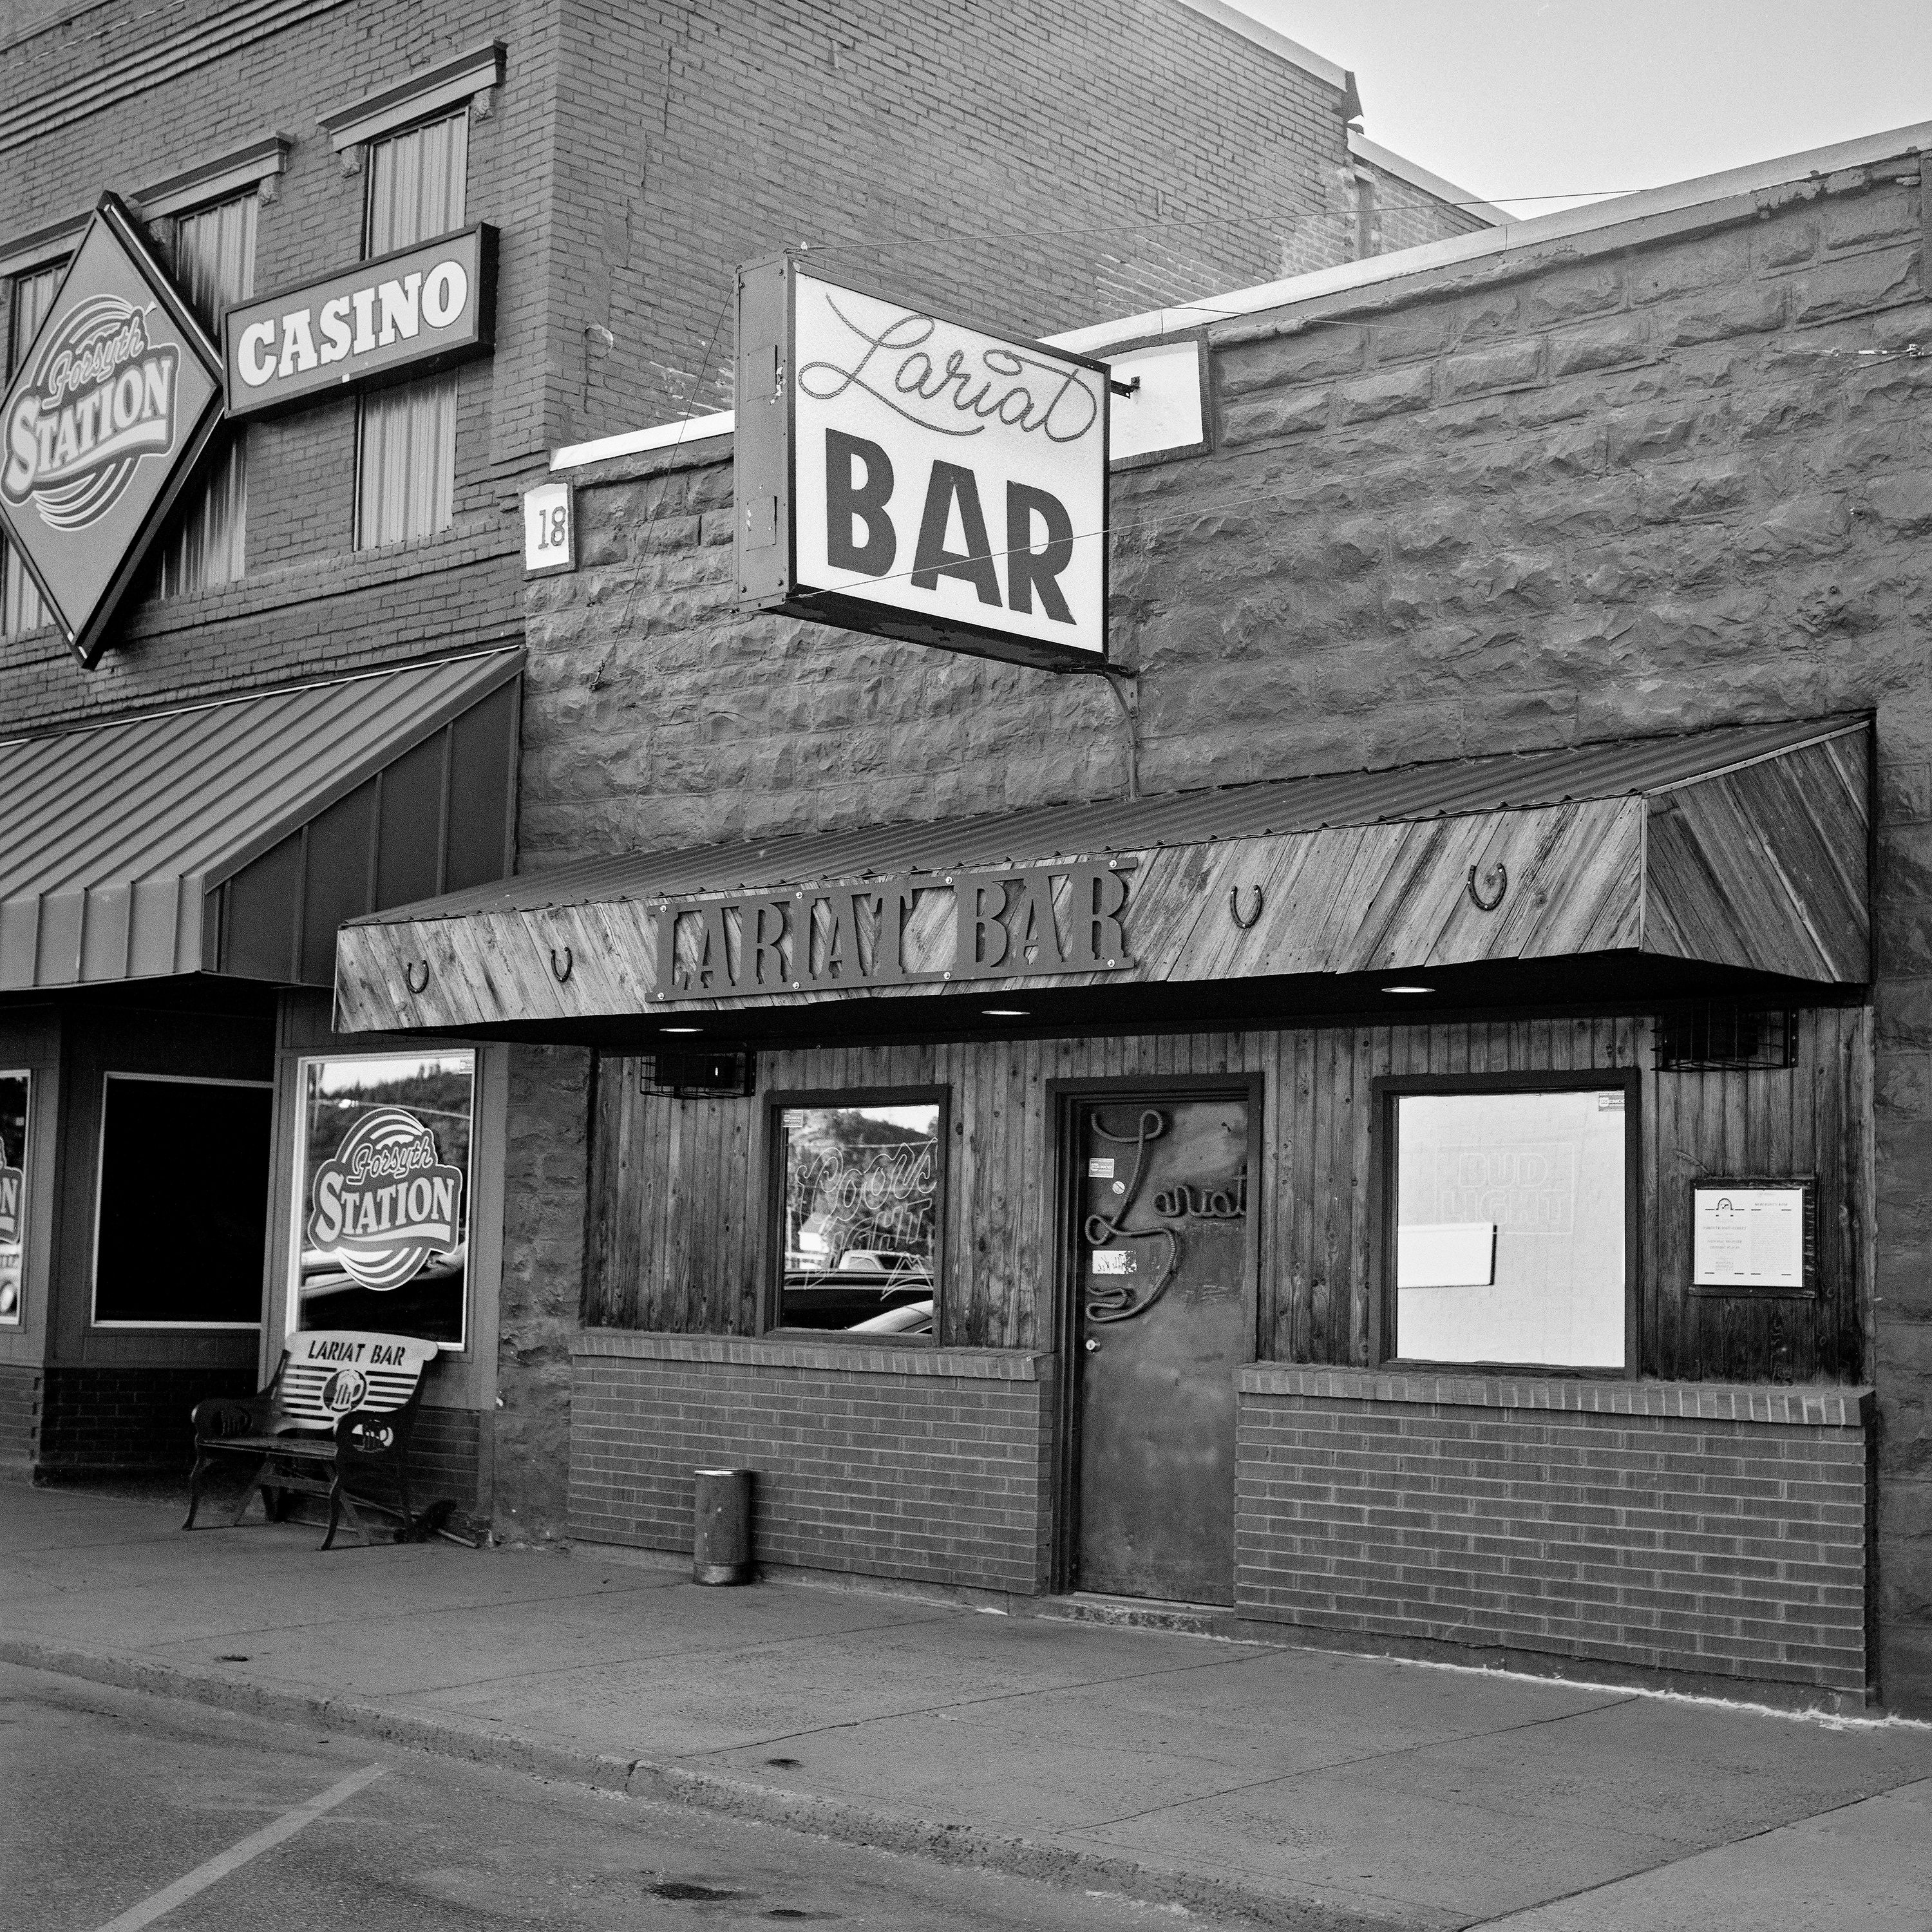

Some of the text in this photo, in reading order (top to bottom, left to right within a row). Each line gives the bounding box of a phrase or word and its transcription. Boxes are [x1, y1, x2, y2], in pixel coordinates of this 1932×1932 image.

[42, 316, 145, 410] Forsyth
[238, 260, 468, 388] CASINO
[798, 292, 1097, 442] Lariat
[6, 358, 172, 492] STATION
[537, 505, 567, 550] 18
[825, 427, 1077, 626] BAR
[649, 863, 1135, 996] LARIAT BAR
[315, 1170, 455, 1243] STATION
[346, 1135, 433, 1186] Forsyth
[795, 1137, 938, 1238] Coors
[1441, 1189, 1569, 1226] LIGHT
[1458, 1152, 1548, 1188] BUD
[307, 1340, 406, 1367] LARIAT BAR
